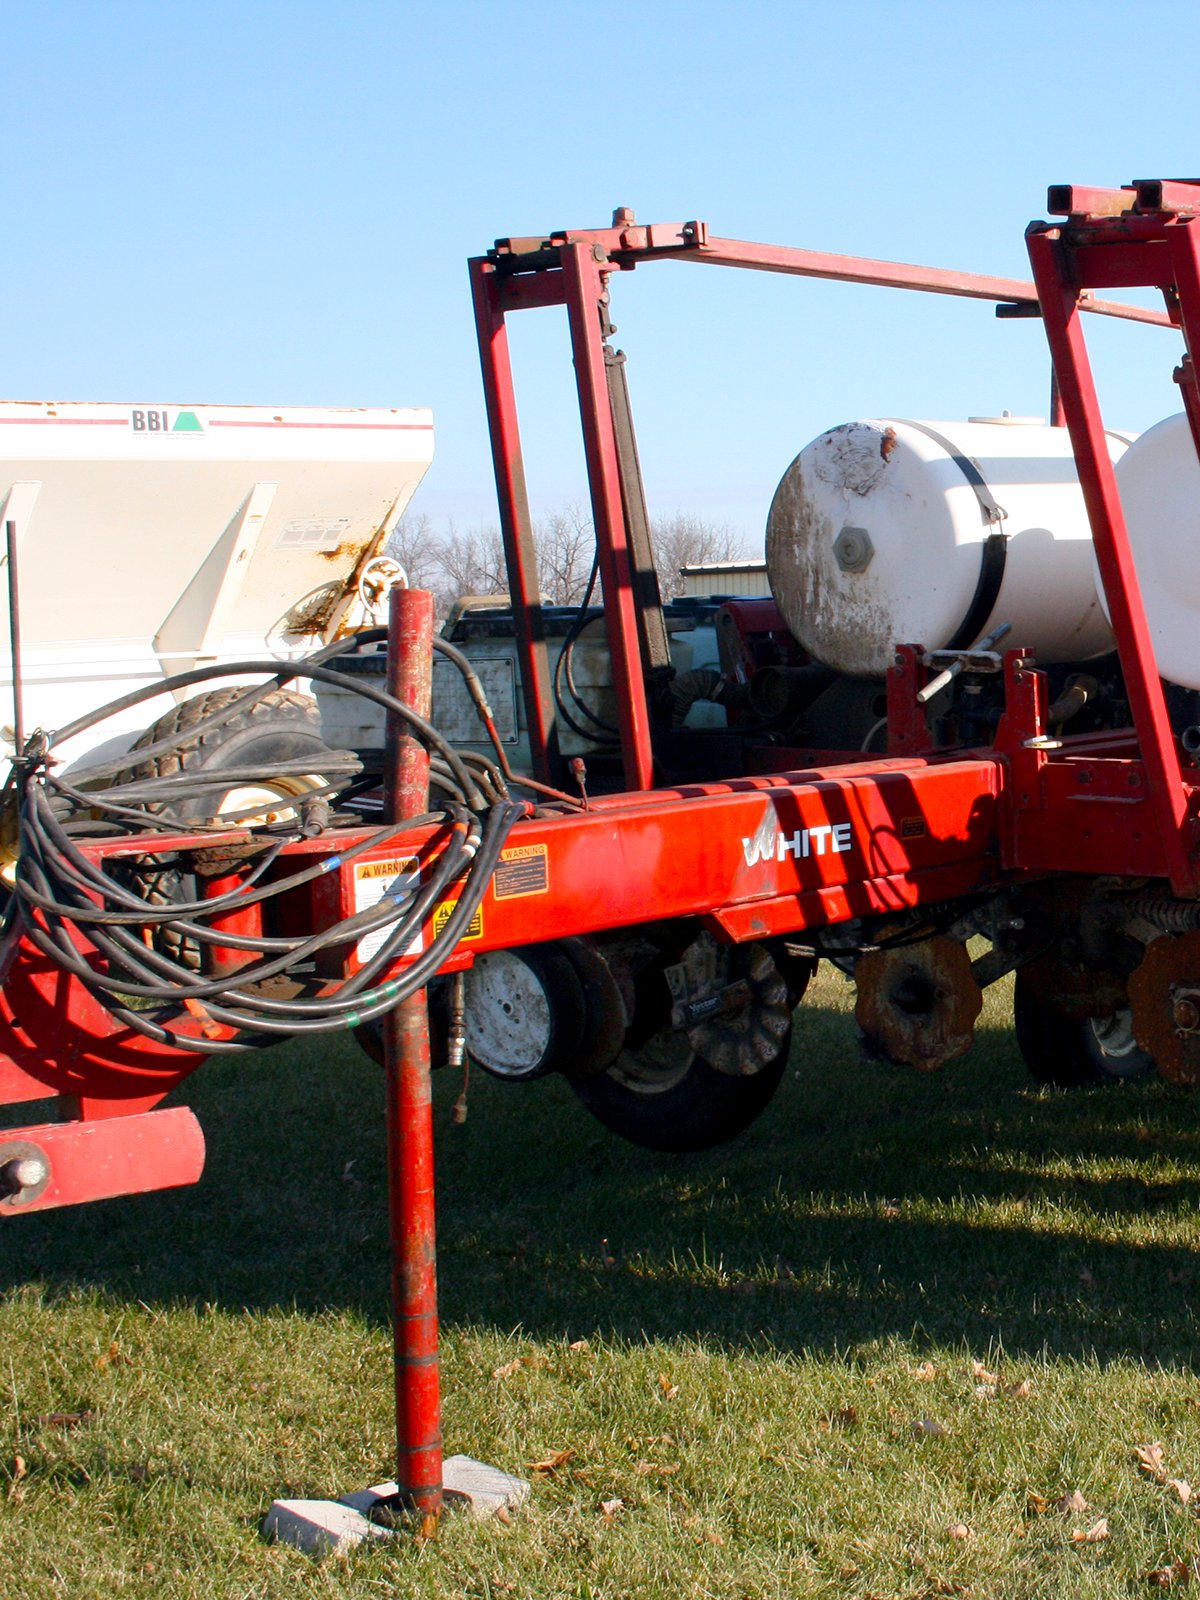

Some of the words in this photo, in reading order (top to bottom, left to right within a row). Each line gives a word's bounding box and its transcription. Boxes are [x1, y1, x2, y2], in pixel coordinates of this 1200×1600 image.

[132, 410, 168, 431] BBI
[505, 844, 545, 859] WARNING
[742, 822, 852, 867] WHITE
[373, 860, 415, 876] WARNING
